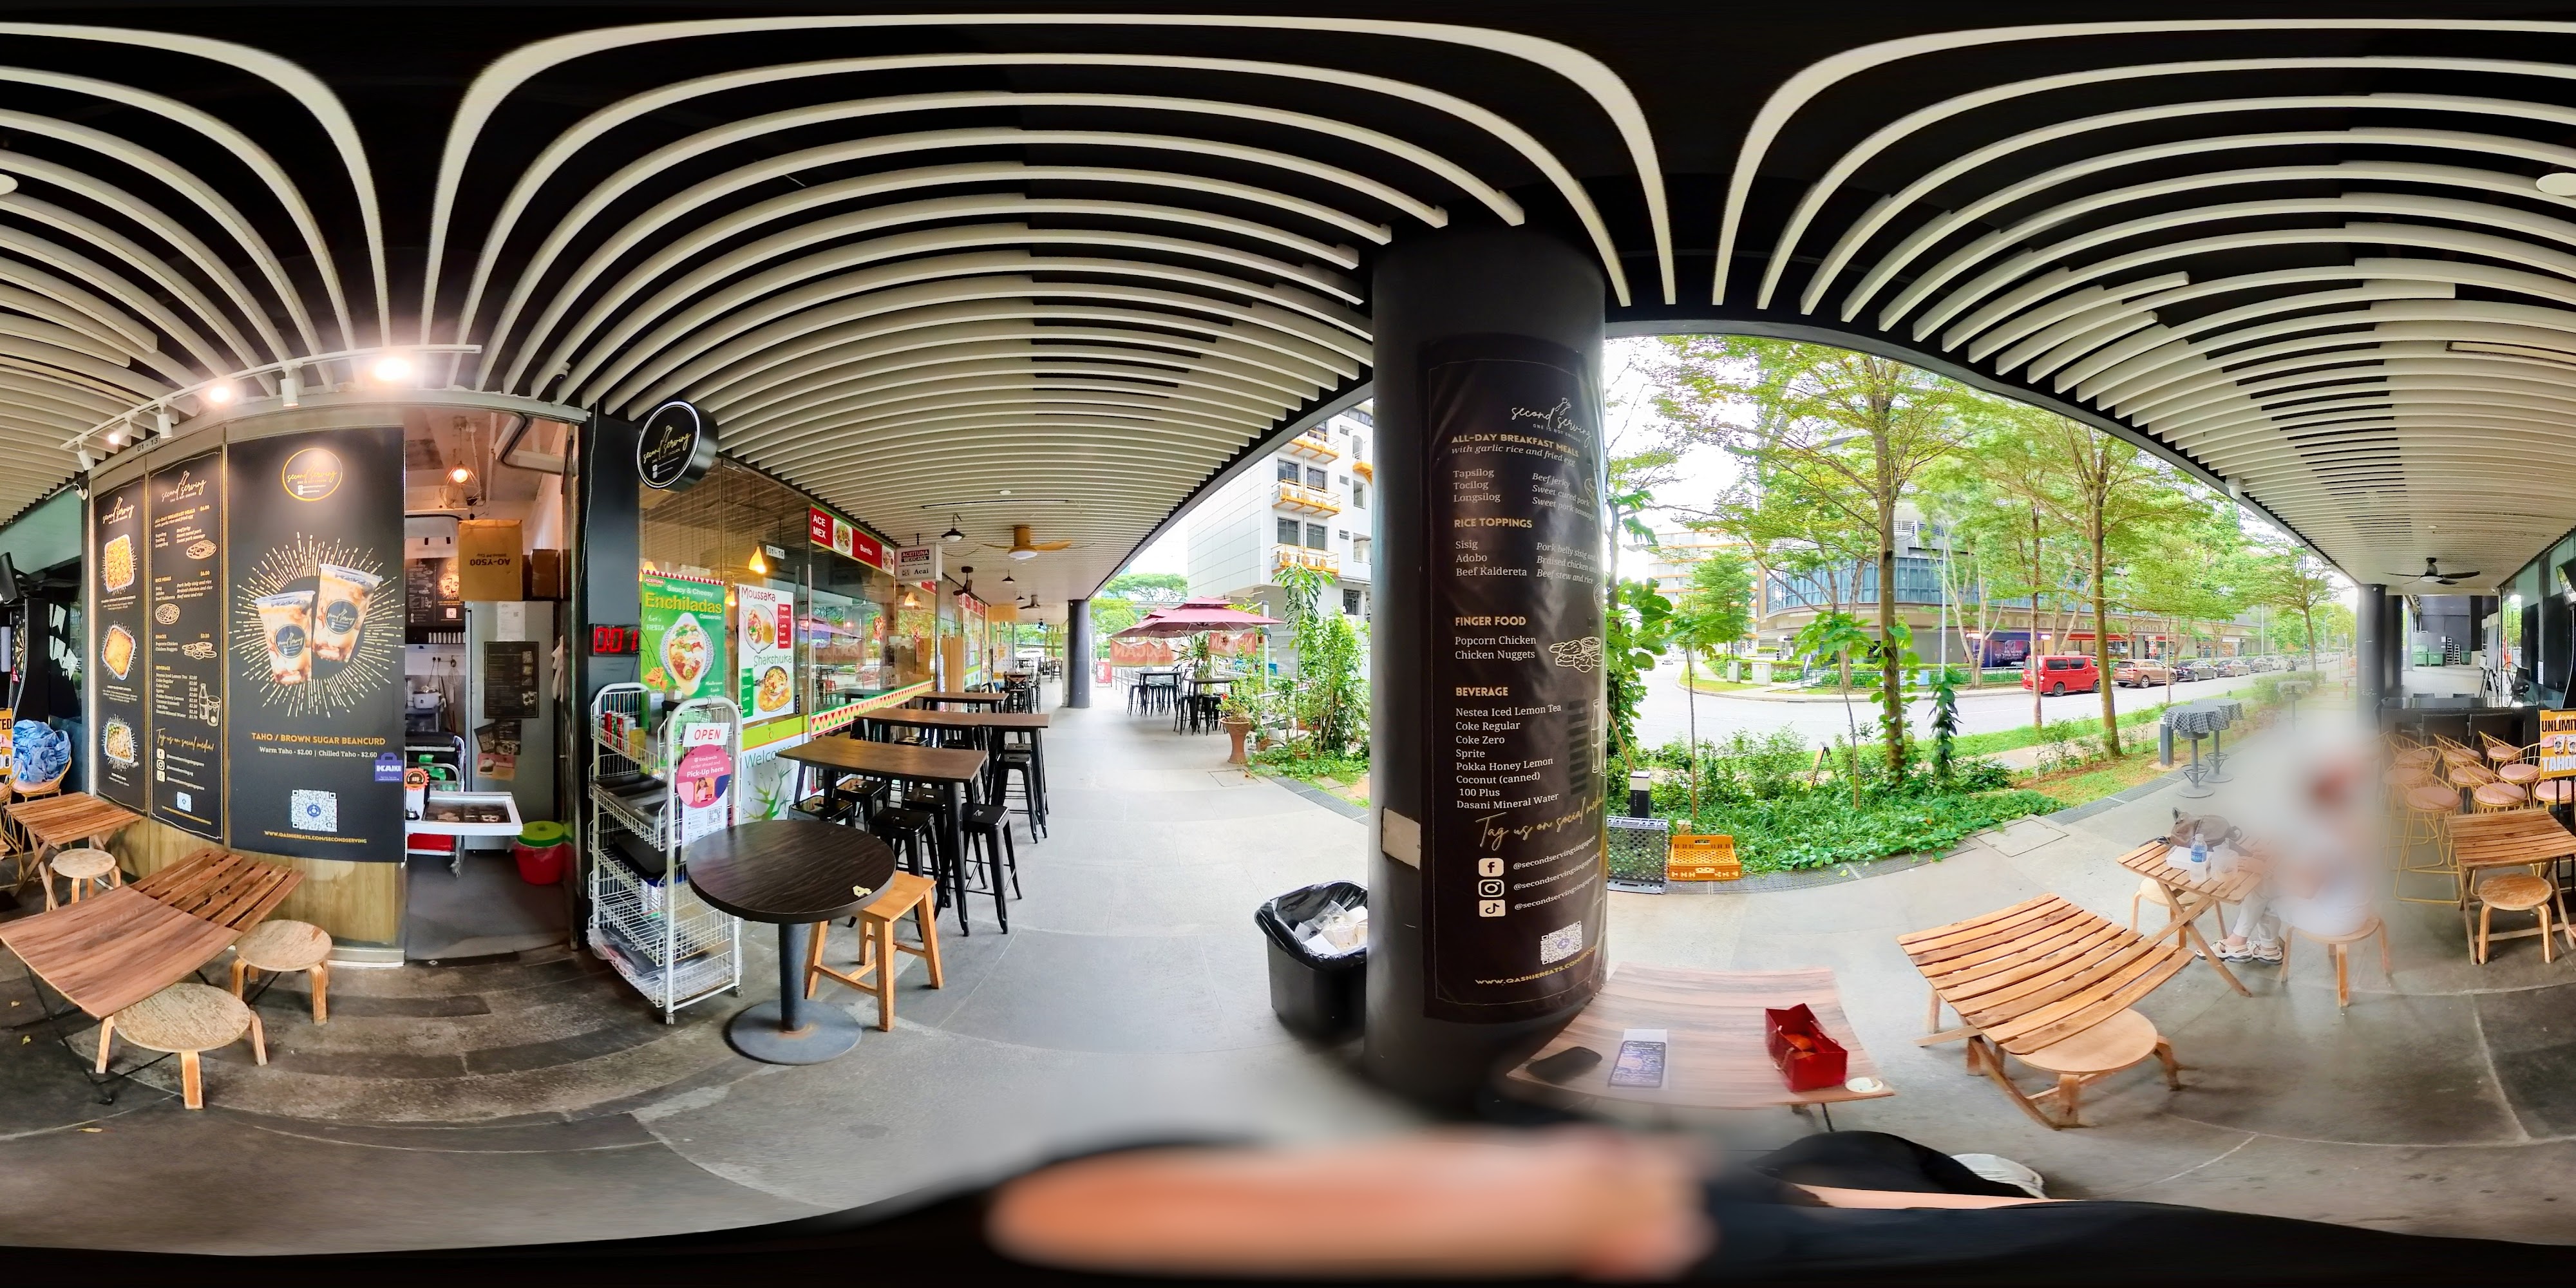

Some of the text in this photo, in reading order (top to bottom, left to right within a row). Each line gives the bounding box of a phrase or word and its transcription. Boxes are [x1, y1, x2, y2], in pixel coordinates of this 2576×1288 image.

[1511, 407, 1592, 448] second serving
[1452, 433, 1579, 458] ALL-DAY BREAKFAST MEALS
[1452, 444, 1576, 467] with garlic rice and fried egg
[1453, 468, 1495, 479] Tapsilog
[1453, 481, 1489, 491] Tocilog
[1532, 473, 1570, 489] Beef jerky
[162, 483, 180, 502] second
[181, 479, 207, 496] serving
[1532, 484, 1591, 507] Sweet cured pork
[1454, 493, 1501, 504] Longsilog
[1532, 497, 1595, 521] Sweet pork sausage
[813, 515, 826, 527] ACE
[1454, 517, 1533, 529] RICE TOPPINGS
[813, 526, 826, 539] MEX
[1455, 540, 1478, 551] Sisig
[1536, 542, 1556, 552] Pork
[1557, 544, 1573, 557] belly
[1574, 547, 1587, 560] sisig
[1456, 553, 1488, 563] Adobo
[1536, 555, 1566, 567] Braised
[1567, 560, 1589, 571] chicken
[1456, 566, 1527, 576] Beef Kaldereta
[1536, 569, 1555, 580] Beef
[1556, 571, 1571, 580] stew
[1584, 576, 1594, 584] rice
[667, 585, 685, 594] Saucy
[692, 589, 714, 597] Cheesy
[741, 587, 776, 602] Moussaka
[645, 592, 723, 614] Enchiladas
[1455, 616, 1526, 626] FINGER FOOD
[594, 626, 638, 653] 001
[1455, 636, 1537, 647] Popcorn Chicken
[753, 654, 793, 668] Shakshuka
[1455, 650, 1535, 661] Chicken Nuggets
[1455, 687, 1508, 696] BEVERAGE
[1455, 704, 1562, 717] Nestea Iced Lemon Tea
[0, 718, 12, 730] ED
[1455, 721, 1520, 733] Coke Regular
[252, 732, 273, 741] TAHO
[281, 734, 311, 743] BROWN
[313, 735, 339, 744] SUGAR
[342, 737, 386, 745] BEANCURD
[694, 729, 721, 740] OPEN
[1455, 735, 1505, 744] Coke Zero
[744, 744, 793, 769] Welco
[1455, 749, 1485, 759] Sprite
[1456, 757, 1553, 772] Pokka Honey Lemon
[687, 768, 710, 778] Pick-Up
[1456, 772, 1540, 784] Coconut (canned)
[1459, 788, 1500, 797] 100 Plus
[1457, 793, 1559, 809] Dasani Mineral Water
[1475, 811, 1509, 851] Tag
[1513, 825, 1533, 841] us
[1537, 822, 1553, 831] on
[1556, 796, 1586, 833] social
